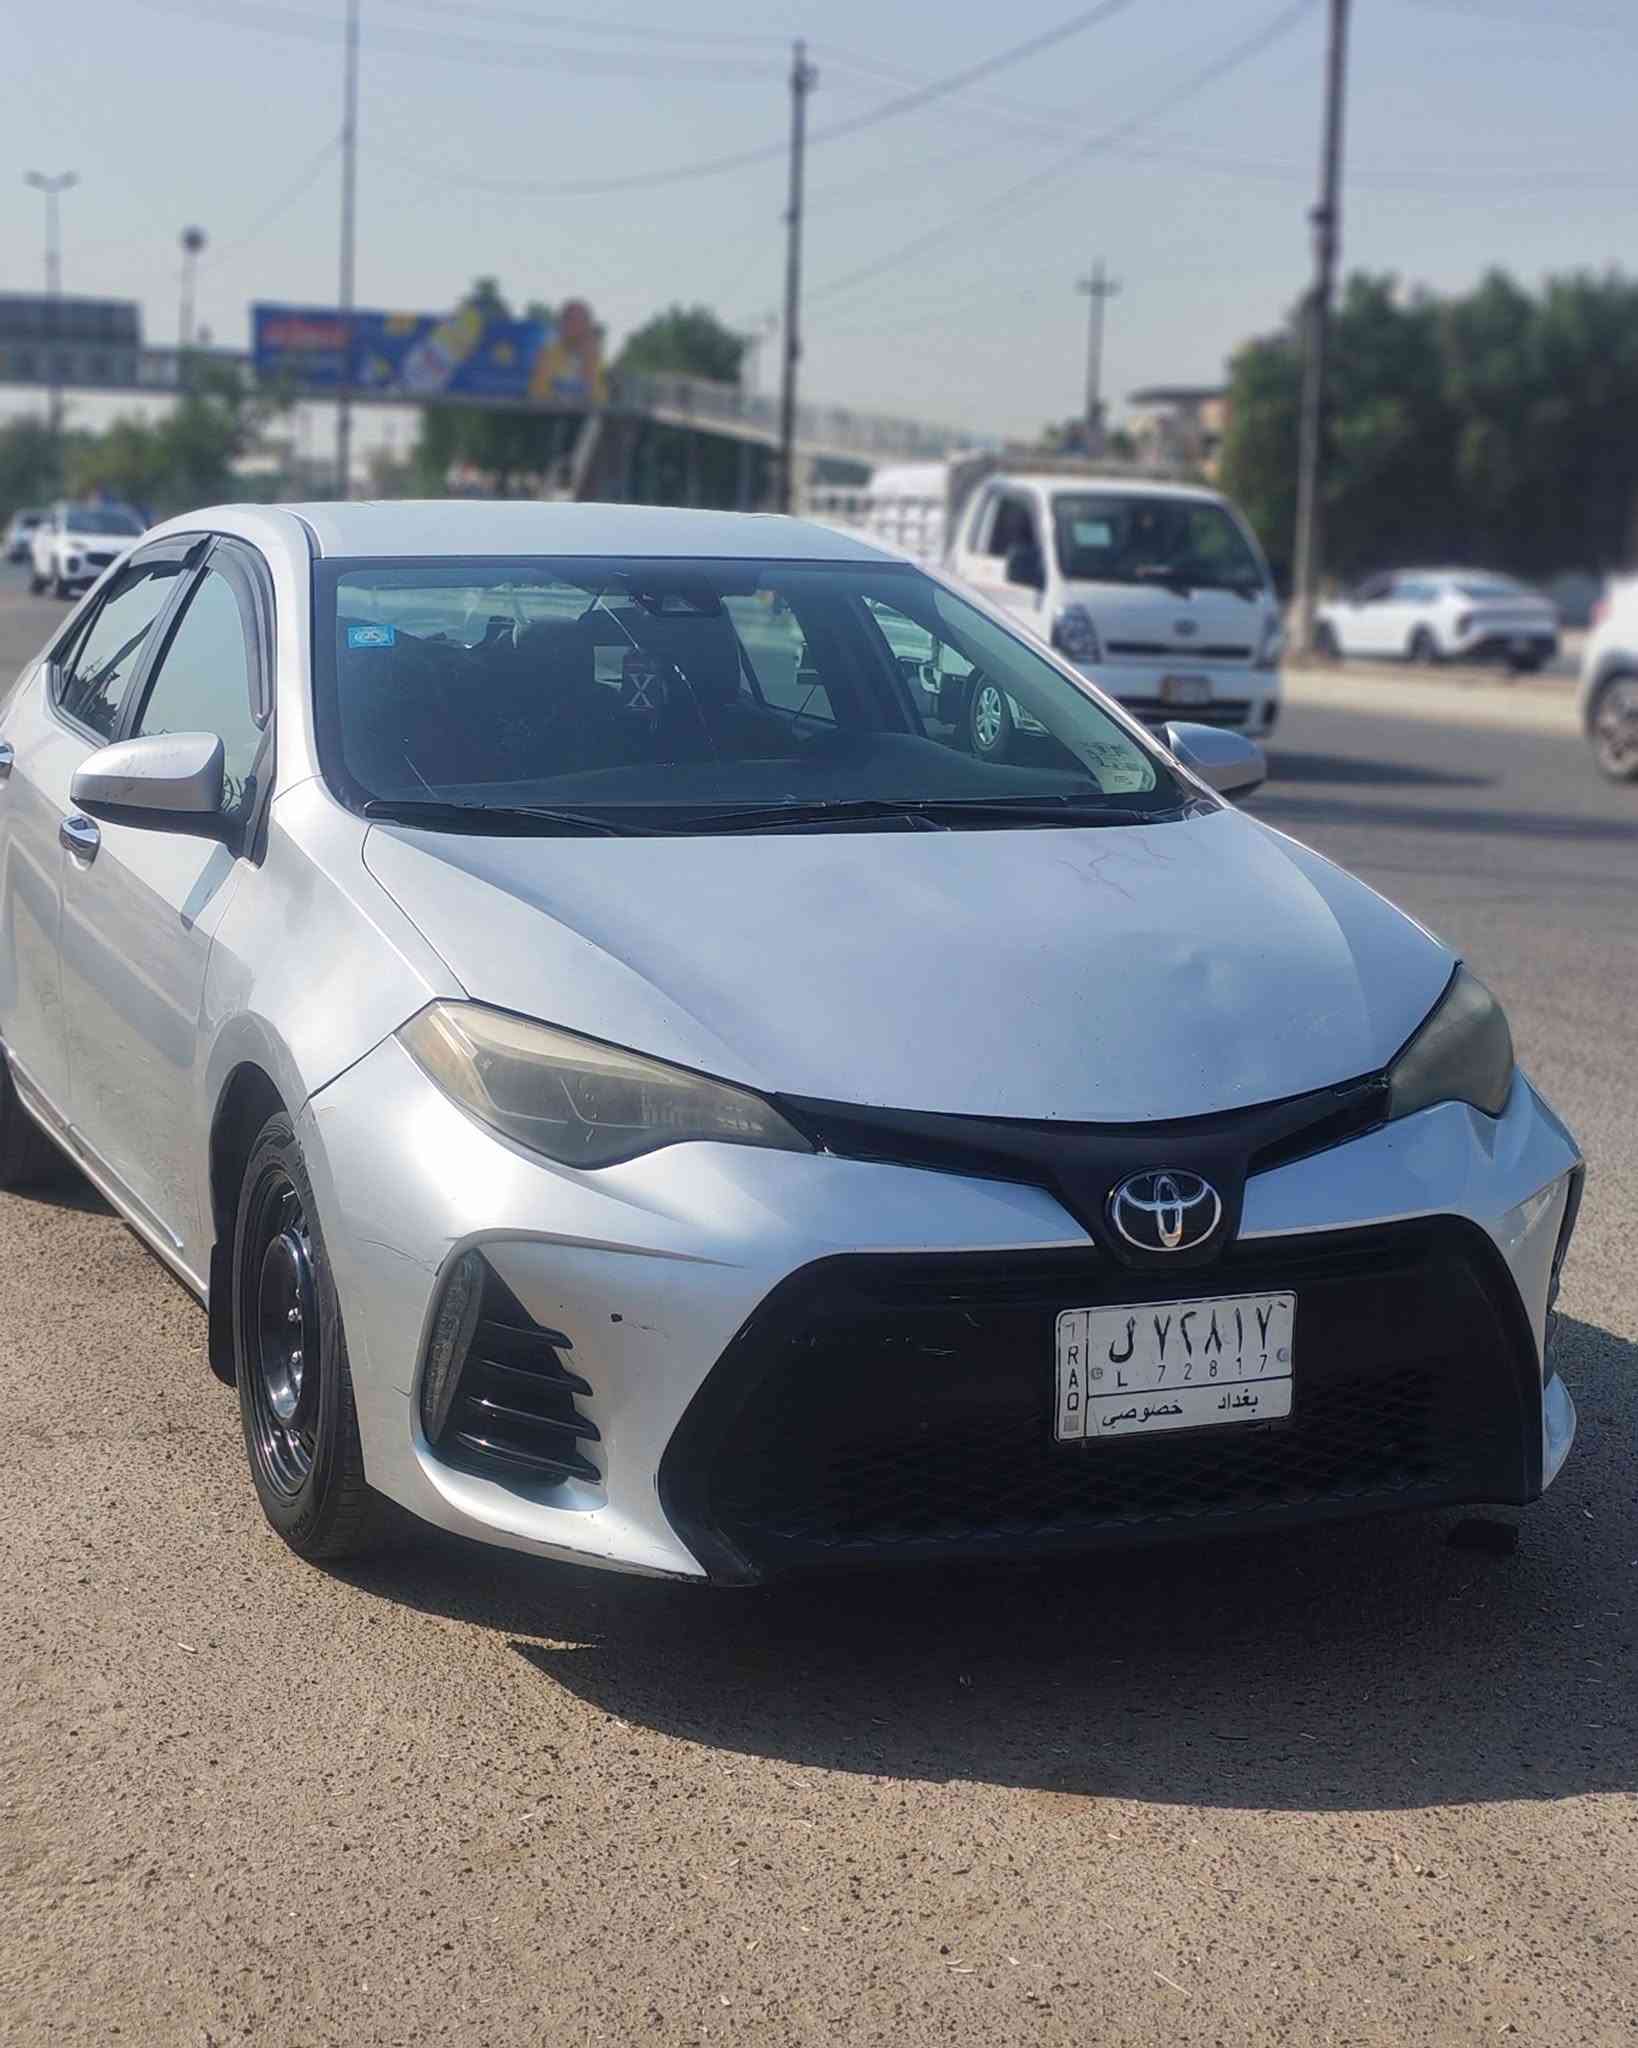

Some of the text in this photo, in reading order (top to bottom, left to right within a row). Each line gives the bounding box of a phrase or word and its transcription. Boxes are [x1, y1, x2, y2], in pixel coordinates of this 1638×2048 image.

[1157, 1354, 1268, 1383] 72817
[1102, 1388, 1259, 1428] بغداد خصوصي
